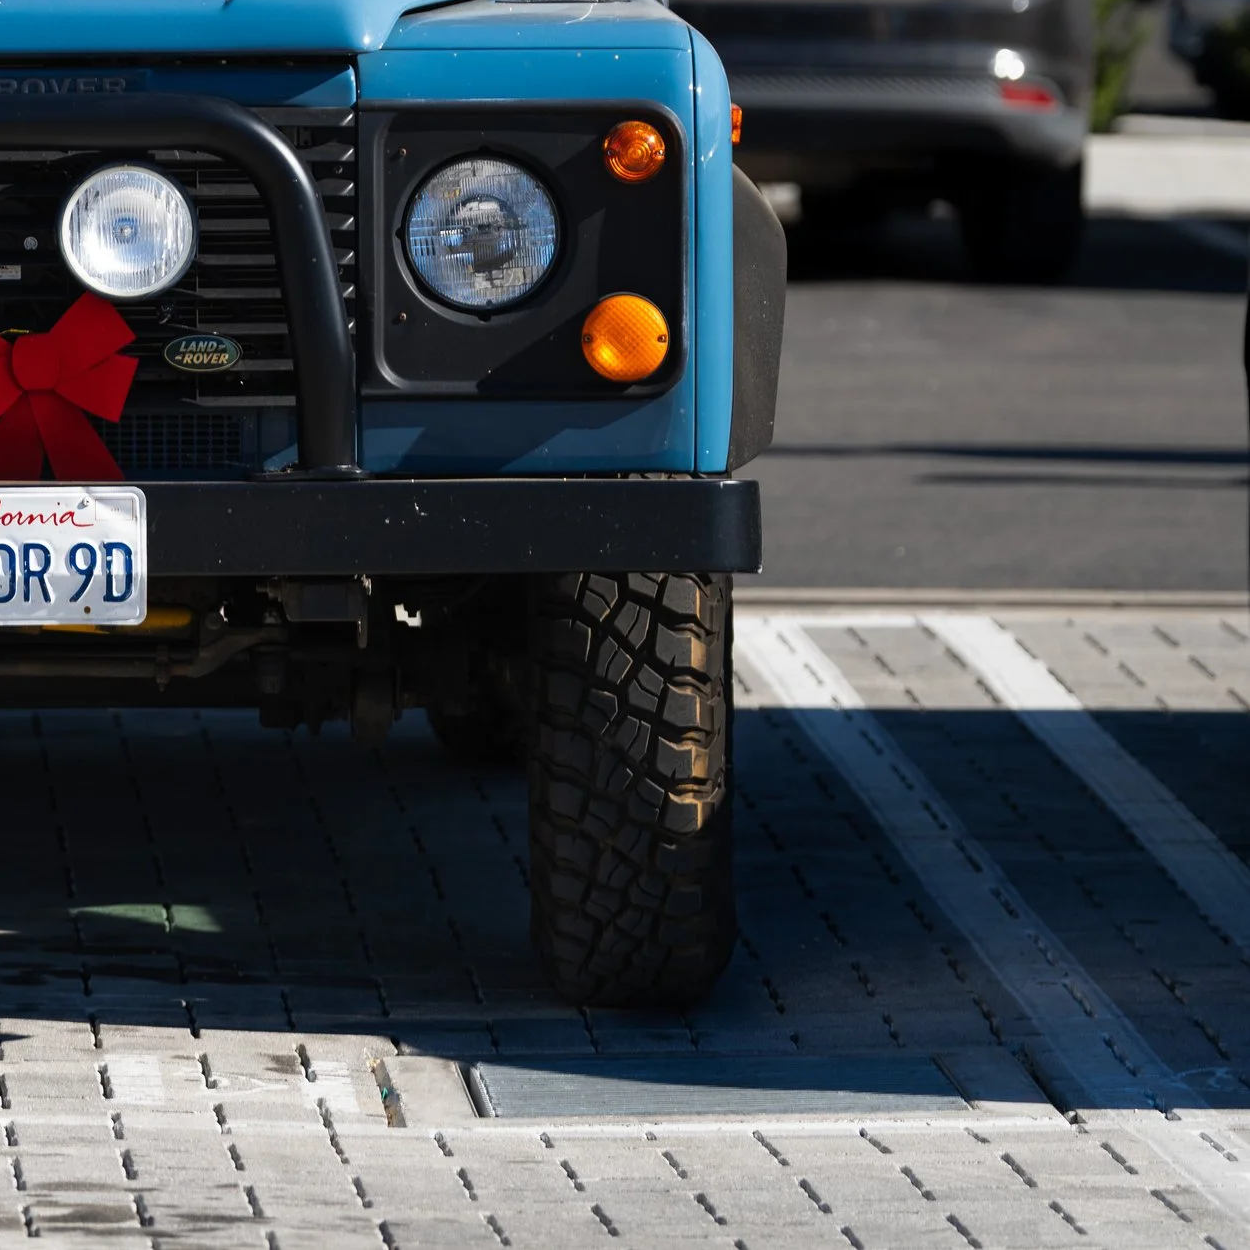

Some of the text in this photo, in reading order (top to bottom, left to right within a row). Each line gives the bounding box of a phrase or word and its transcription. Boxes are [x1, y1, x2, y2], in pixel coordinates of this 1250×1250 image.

[179, 340, 218, 352] LAND
[182, 353, 229, 365] ROVER
[68, 541, 134, 603] 9D
